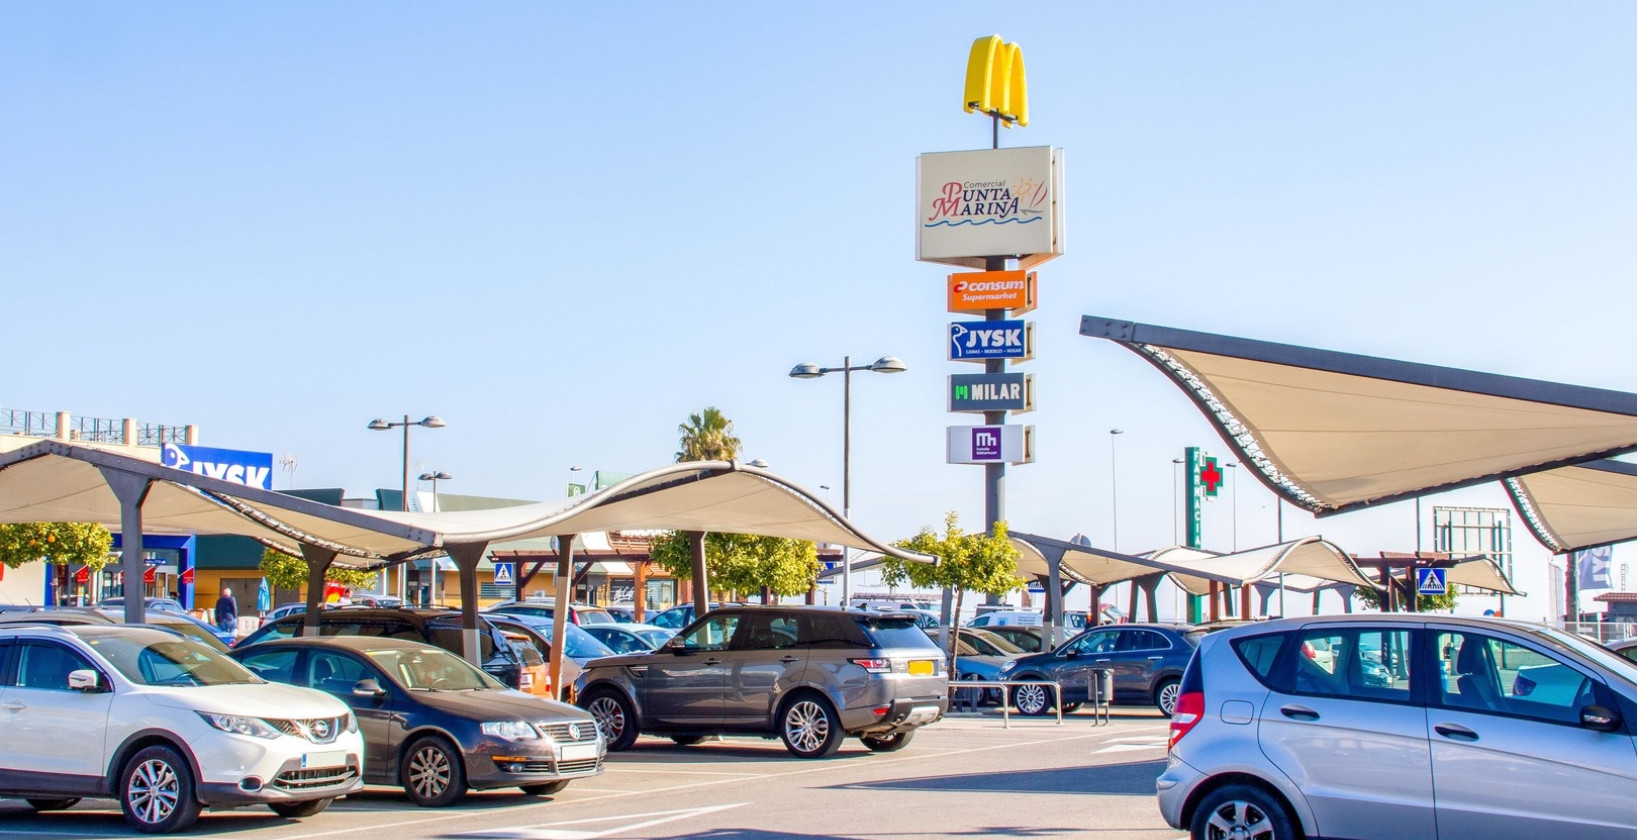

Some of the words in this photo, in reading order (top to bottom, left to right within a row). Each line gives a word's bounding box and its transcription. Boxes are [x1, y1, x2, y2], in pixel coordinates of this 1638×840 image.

[942, 181, 1012, 203] PUNTA
[964, 180, 1006, 189] Comercial
[928, 197, 1020, 222] MARINA
[968, 280, 1024, 292] consum
[962, 292, 1017, 302] Supermarket
[966, 328, 1022, 348] JYSK
[971, 383, 1020, 400] MILAR
[1193, 450, 1201, 545] FARMACIA
[1592, 545, 1611, 586] JYS
